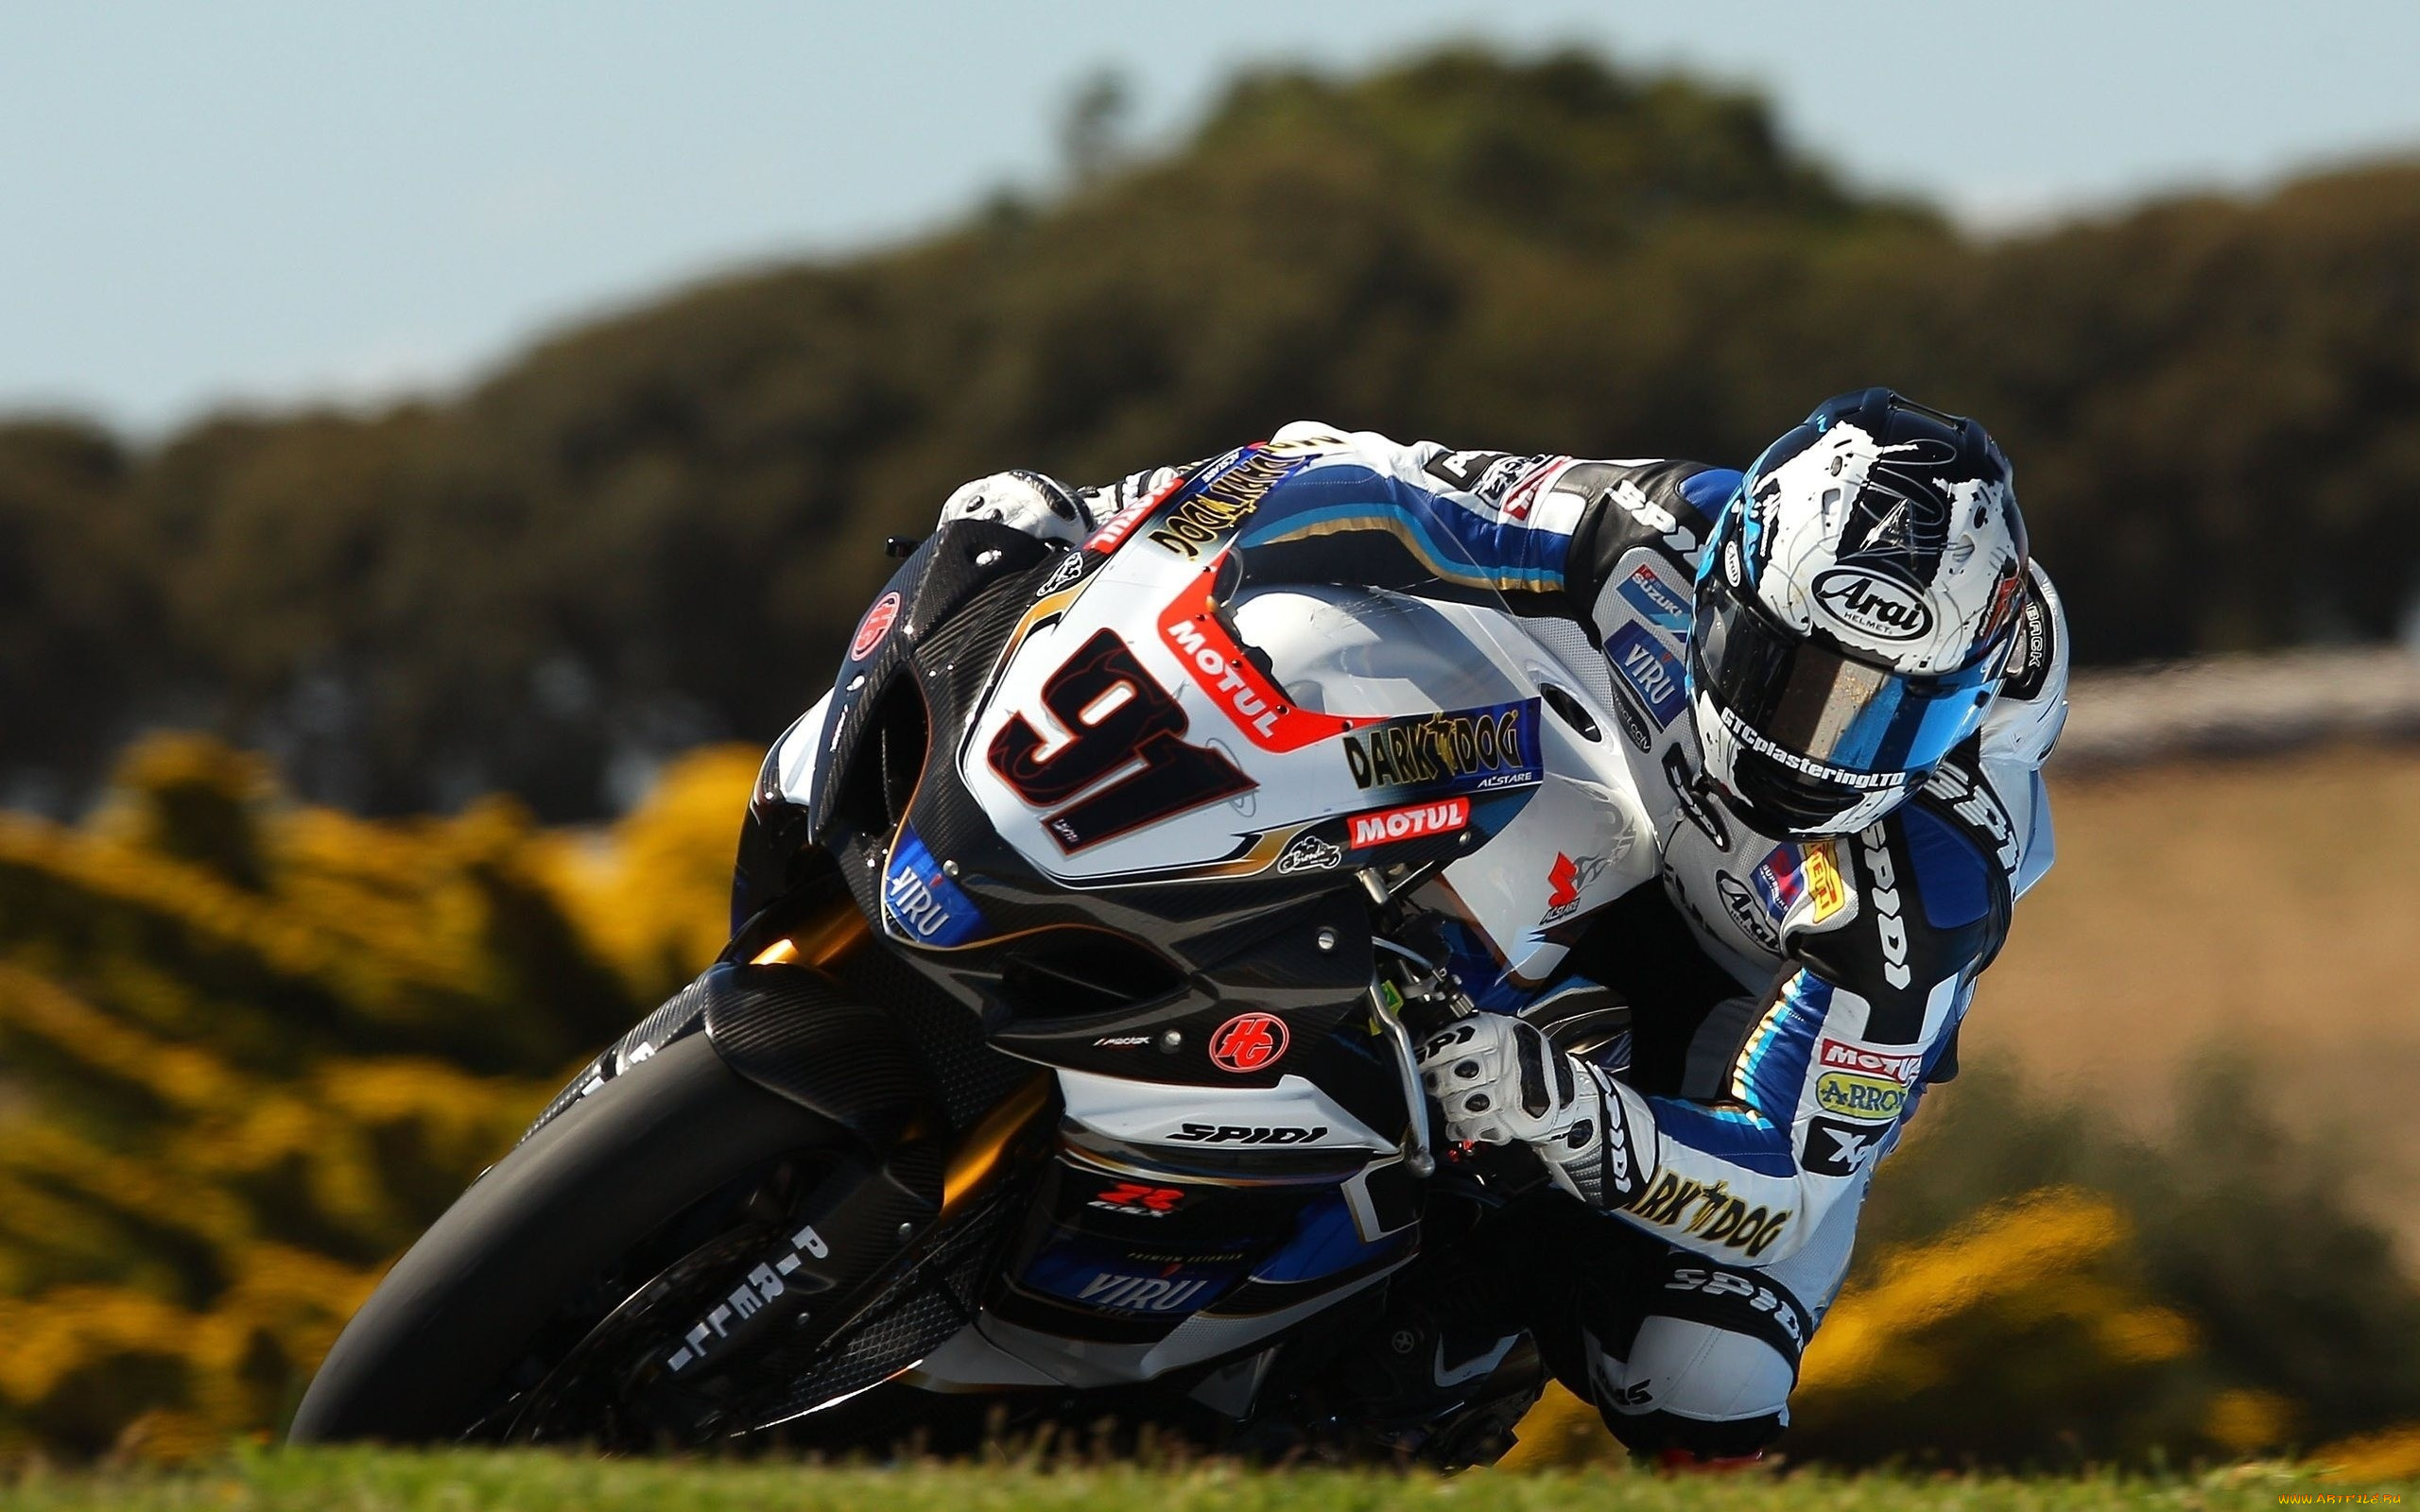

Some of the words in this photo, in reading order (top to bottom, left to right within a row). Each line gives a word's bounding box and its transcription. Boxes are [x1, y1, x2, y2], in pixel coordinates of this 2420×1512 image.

[1147, 497, 1232, 561] DOG
[1632, 572, 1683, 617] SUZUKI
[1815, 576, 1923, 631] Arai
[1167, 619, 1278, 739] MOTUL
[1624, 643, 1675, 704] VIRU
[987, 627, 1259, 856] 91
[1343, 726, 1440, 790] DARK
[1454, 711, 1524, 775] DOG
[1355, 801, 1463, 845] MOTUL
[890, 865, 950, 936] VIRU
[1860, 818, 1911, 990] SPIDI
[1167, 1123, 1328, 1144] SPIDI
[1697, 1197, 1792, 1258] DOG
[666, 1226, 828, 1371] PIRELLI
[1077, 1273, 1208, 1311] VIRU
